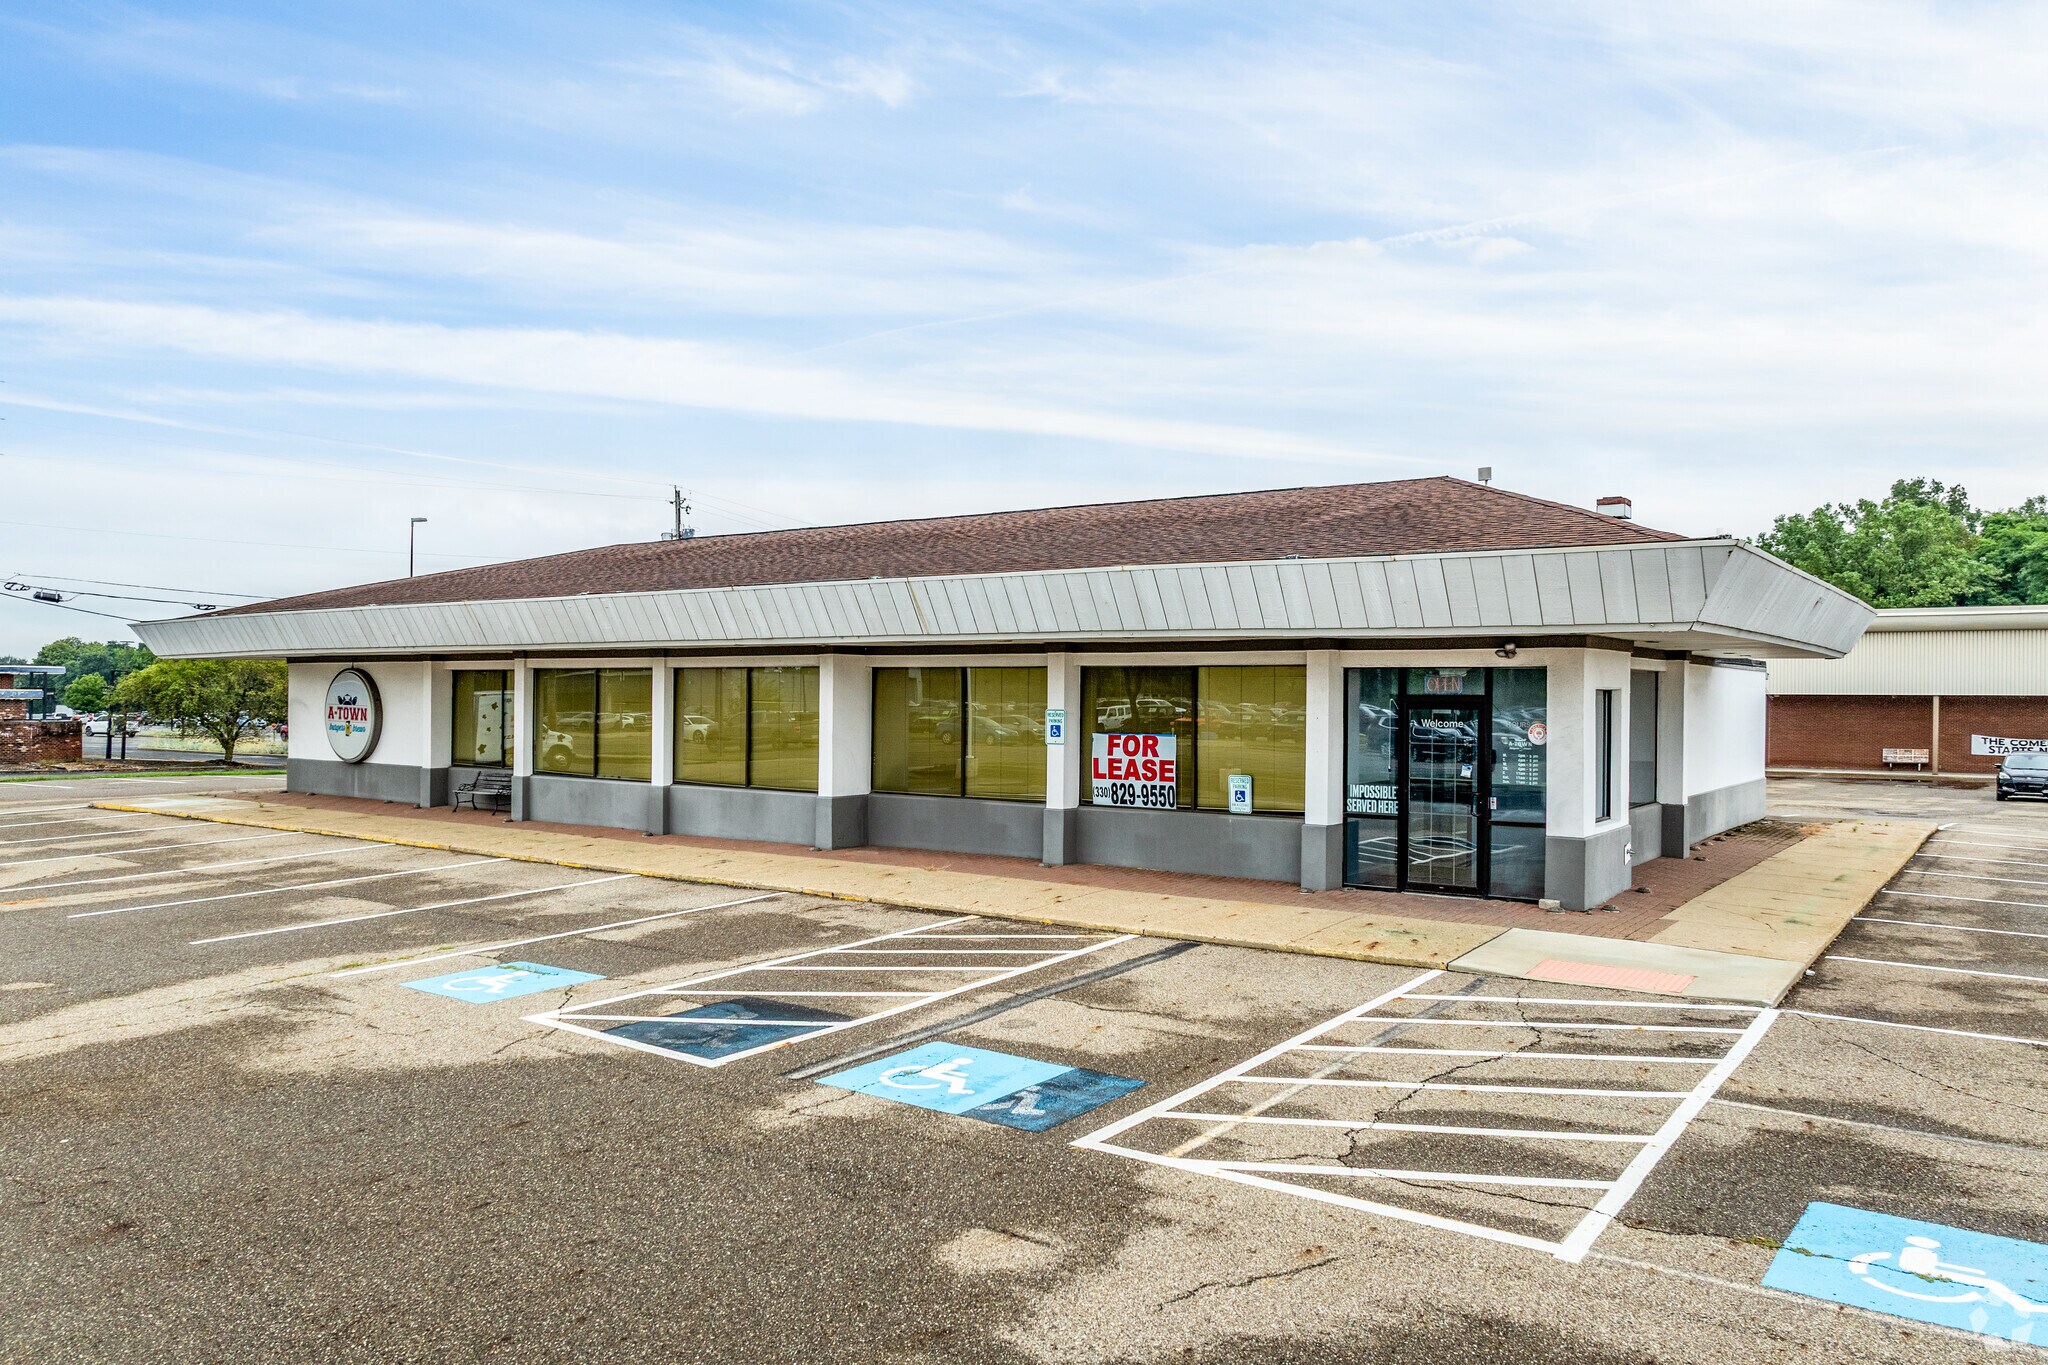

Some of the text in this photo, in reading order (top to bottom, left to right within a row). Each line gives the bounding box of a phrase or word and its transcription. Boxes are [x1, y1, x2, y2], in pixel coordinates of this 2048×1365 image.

[1427, 677, 1460, 692] OPEN
[1421, 718, 1464, 728] Welcome
[1107, 734, 1159, 757] FOR
[1981, 737, 2005, 746] THE
[1093, 757, 1174, 782] LEASE
[1093, 782, 1175, 808] (330) 829-9550
[1349, 784, 1397, 799] IMPOSSIBLE
[1346, 798, 1398, 814] SERVED HERE
